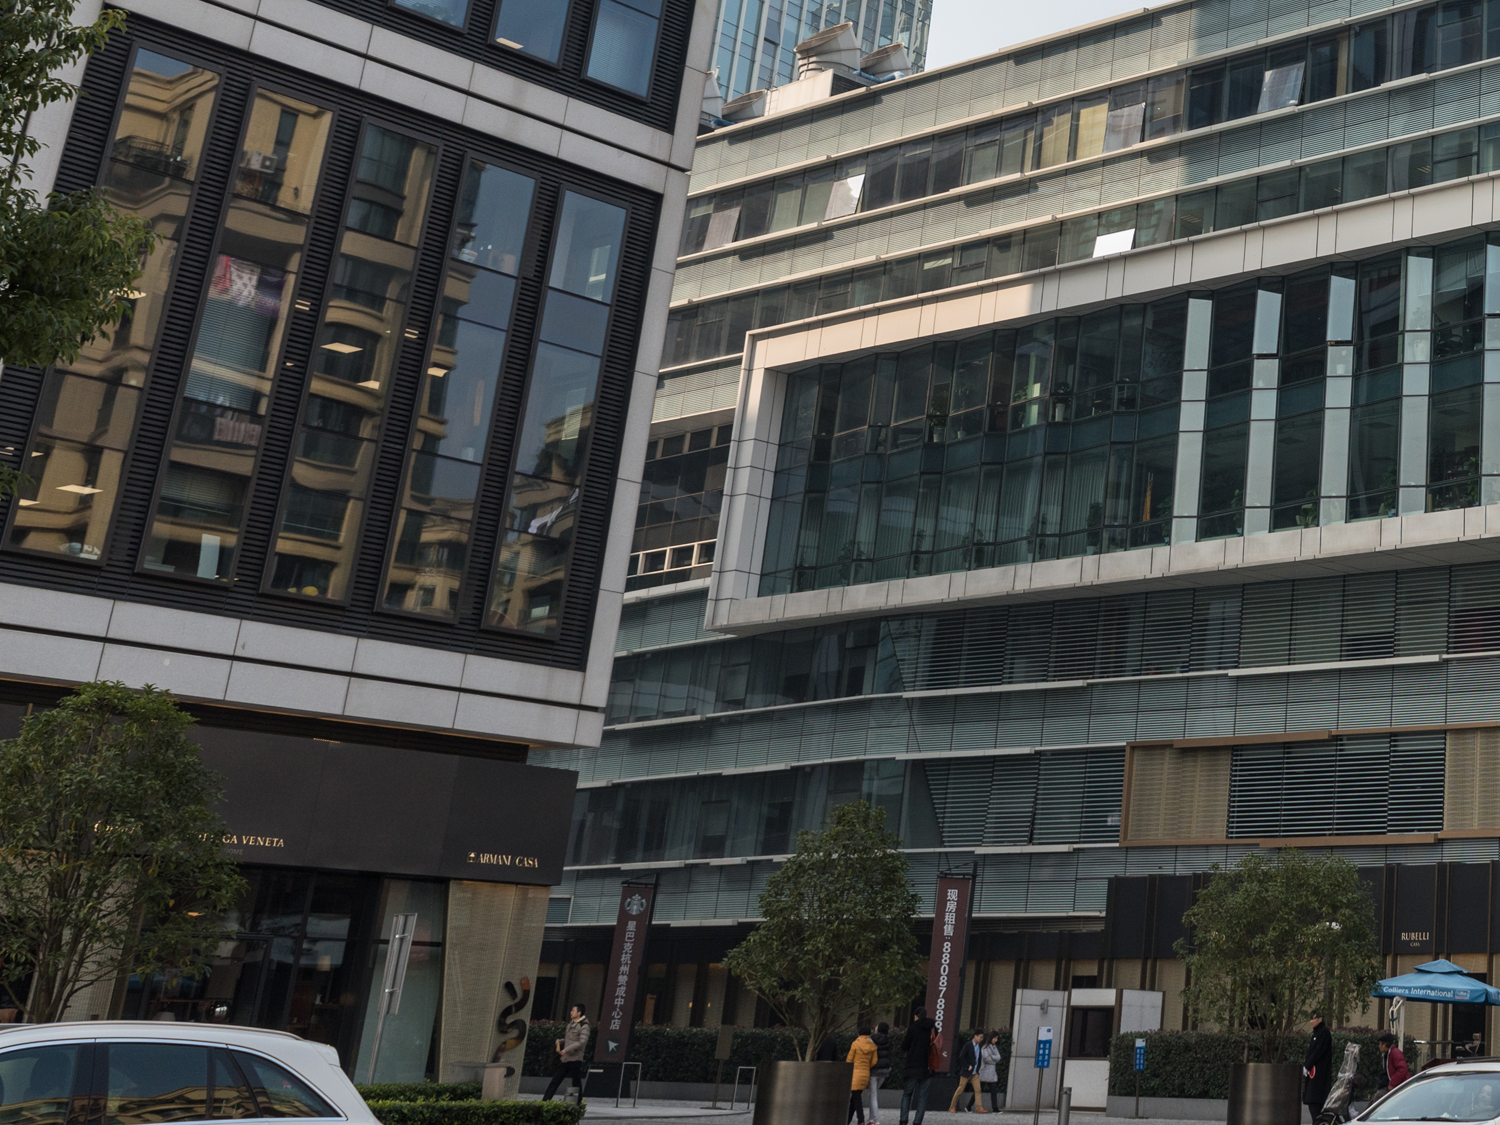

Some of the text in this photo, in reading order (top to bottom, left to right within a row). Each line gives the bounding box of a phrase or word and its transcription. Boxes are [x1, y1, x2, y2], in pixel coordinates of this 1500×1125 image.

[242, 835, 285, 848] VENETA
[478, 853, 511, 866] ARMANI
[515, 855, 539, 868] CASA
[1401, 932, 1430, 941] RUBELLI
[1383, 986, 1409, 995] Colliers
[1410, 987, 1454, 999] International
